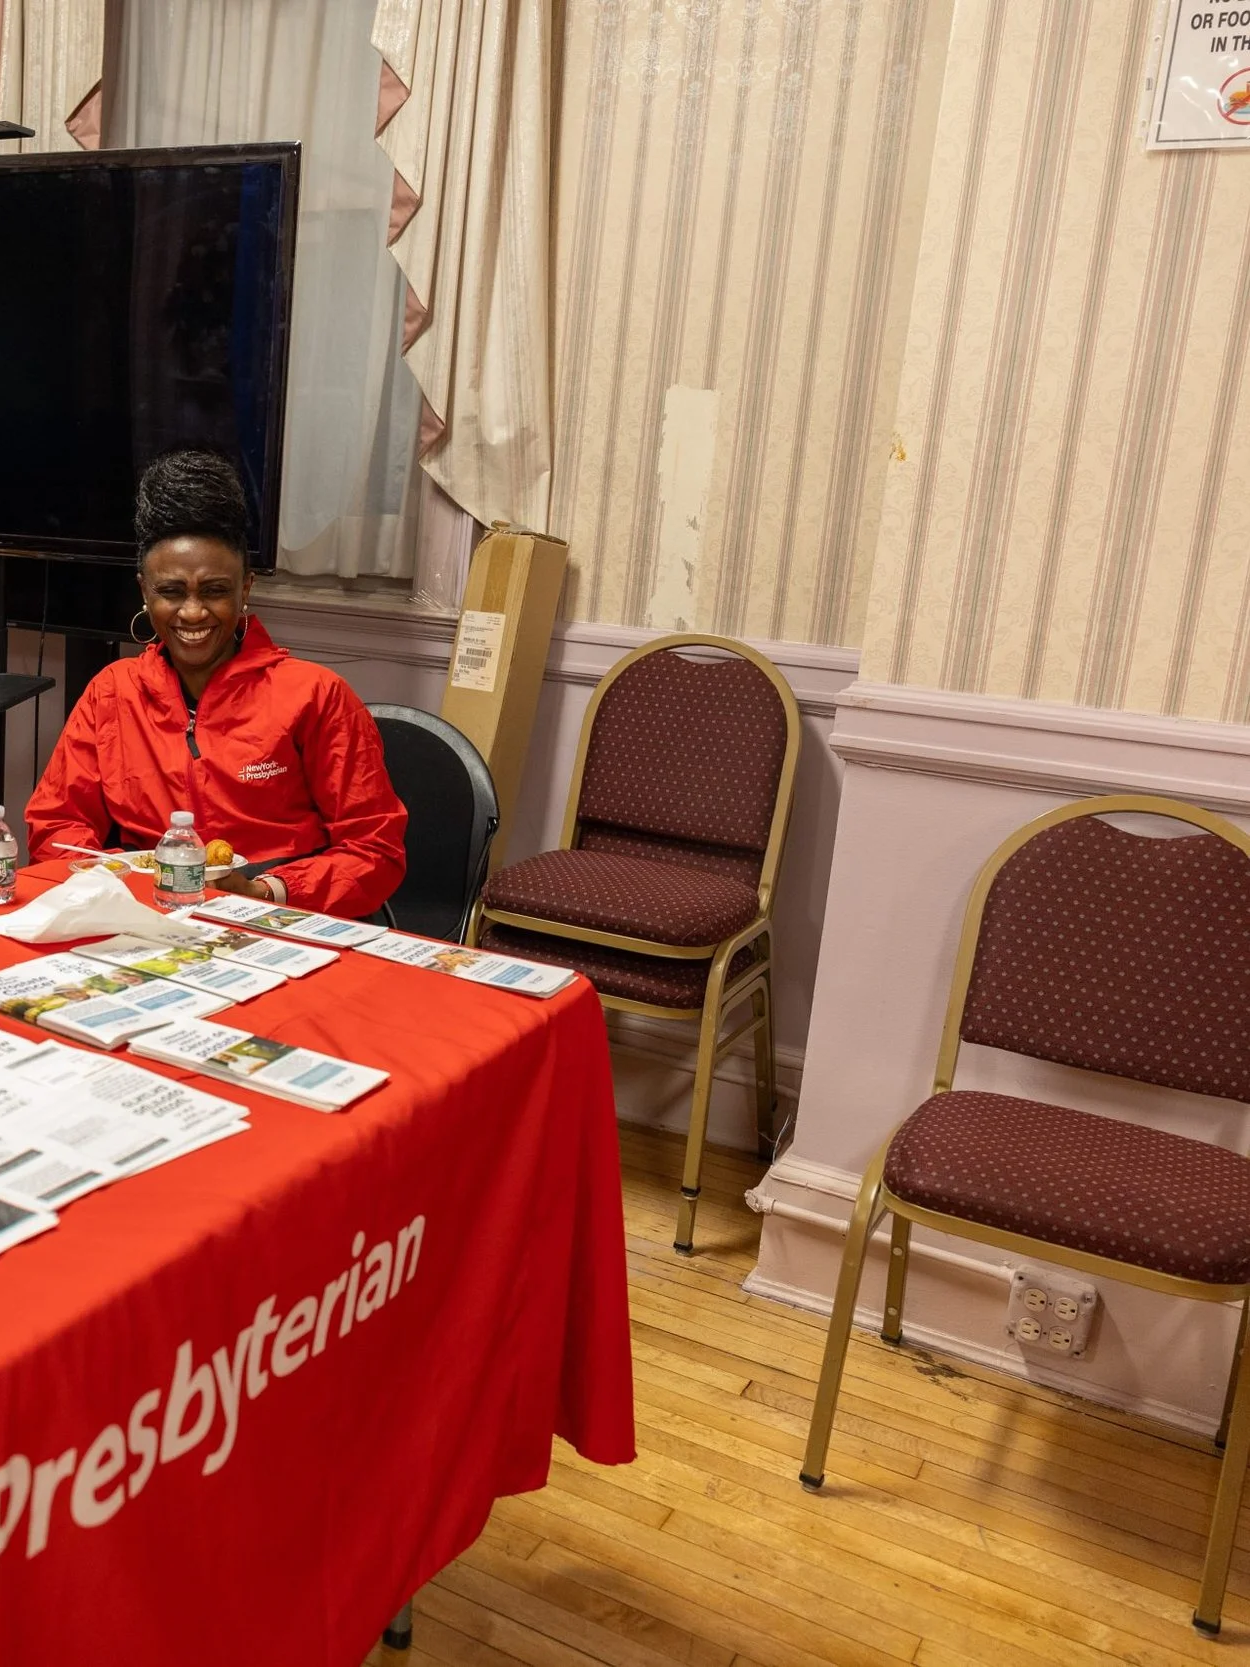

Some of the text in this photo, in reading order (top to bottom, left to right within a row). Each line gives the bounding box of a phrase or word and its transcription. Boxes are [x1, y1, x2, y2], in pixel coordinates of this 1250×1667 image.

[1190, 13, 1214, 30] OR
[1210, 36, 1228, 53] IN
[246, 766, 288, 780] Presbyterian
